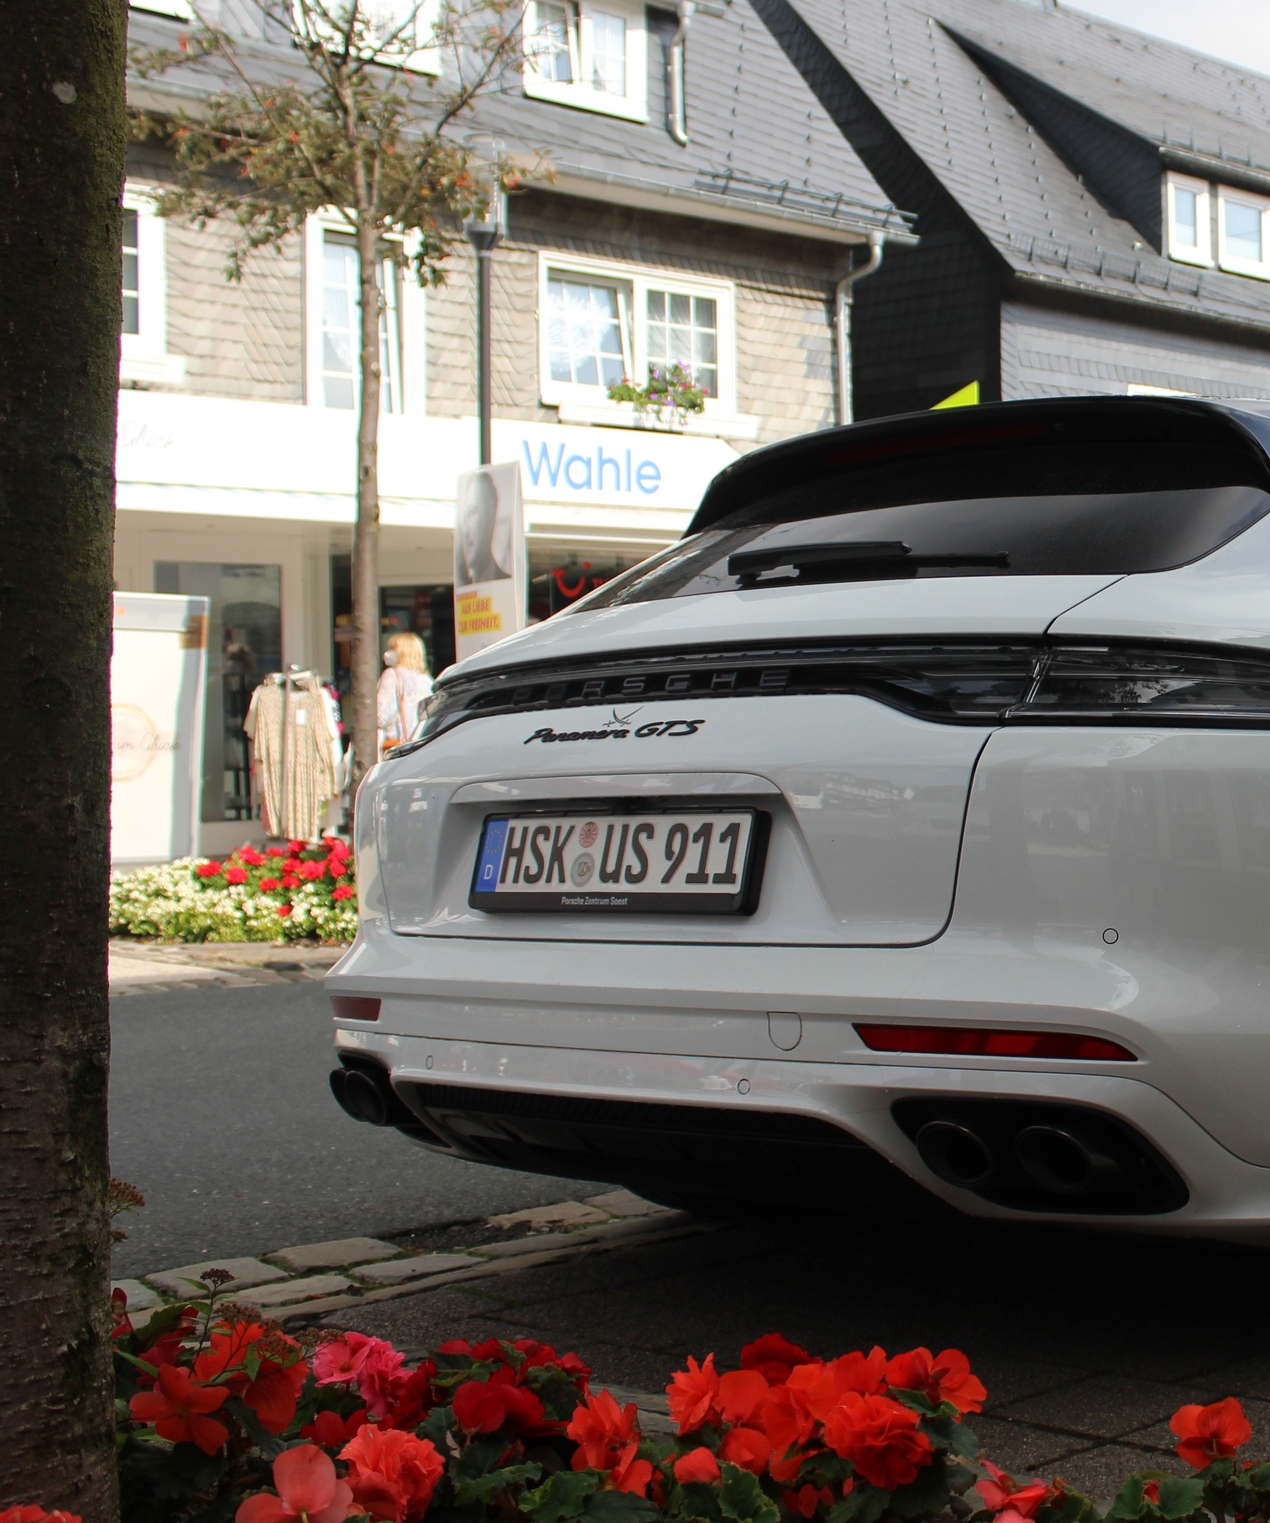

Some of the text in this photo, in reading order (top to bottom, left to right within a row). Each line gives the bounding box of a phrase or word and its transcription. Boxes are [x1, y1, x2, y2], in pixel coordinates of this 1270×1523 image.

[522, 439, 661, 494] Wahle
[511, 669, 790, 707] PORSCHE
[524, 719, 706, 745] Panamera GTS
[499, 822, 741, 885] HSK US 911
[483, 864, 493, 880] D
[561, 896, 628, 906] Porsche Zentrum Soest
